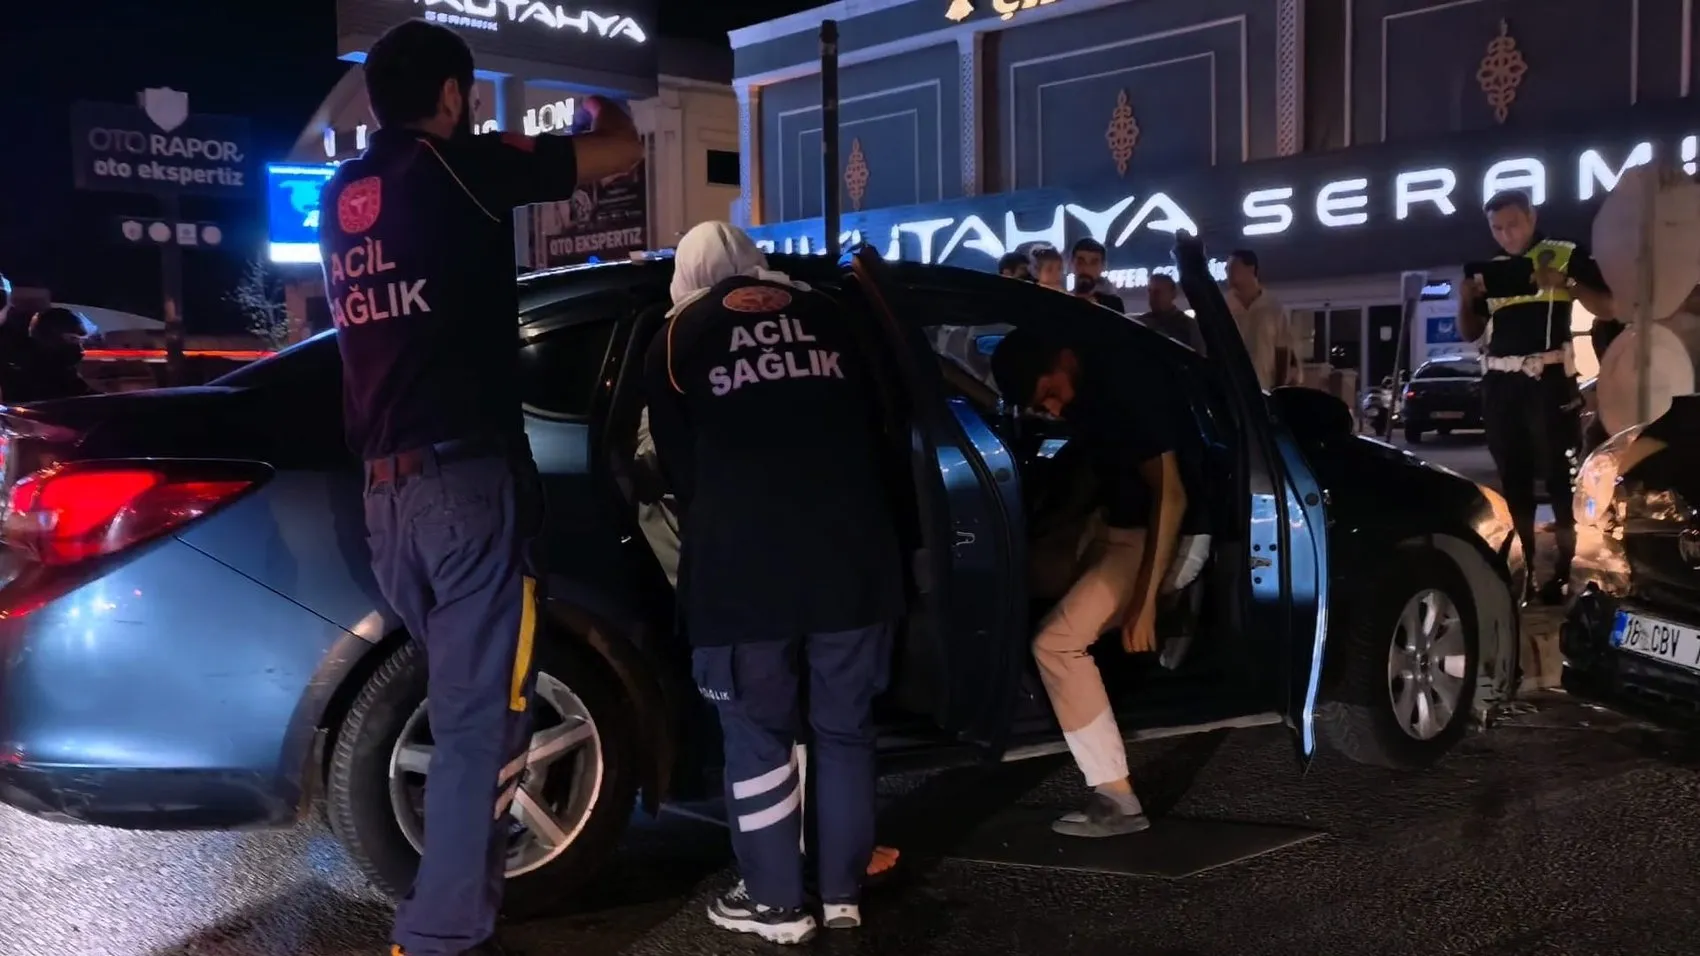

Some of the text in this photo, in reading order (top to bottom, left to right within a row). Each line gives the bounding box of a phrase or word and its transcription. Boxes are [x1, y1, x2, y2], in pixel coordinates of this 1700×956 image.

[88, 127, 244, 163] OTO RAPOR
[93, 157, 244, 187] oto ekspertiz
[331, 236, 396, 285] ACİL
[550, 239, 573, 256] OTO
[332, 278, 431, 327] AĞLIK
[729, 314, 816, 352] ACİL
[708, 347, 844, 396] SAĞLIK
[1651, 625, 1680, 657] CBV
